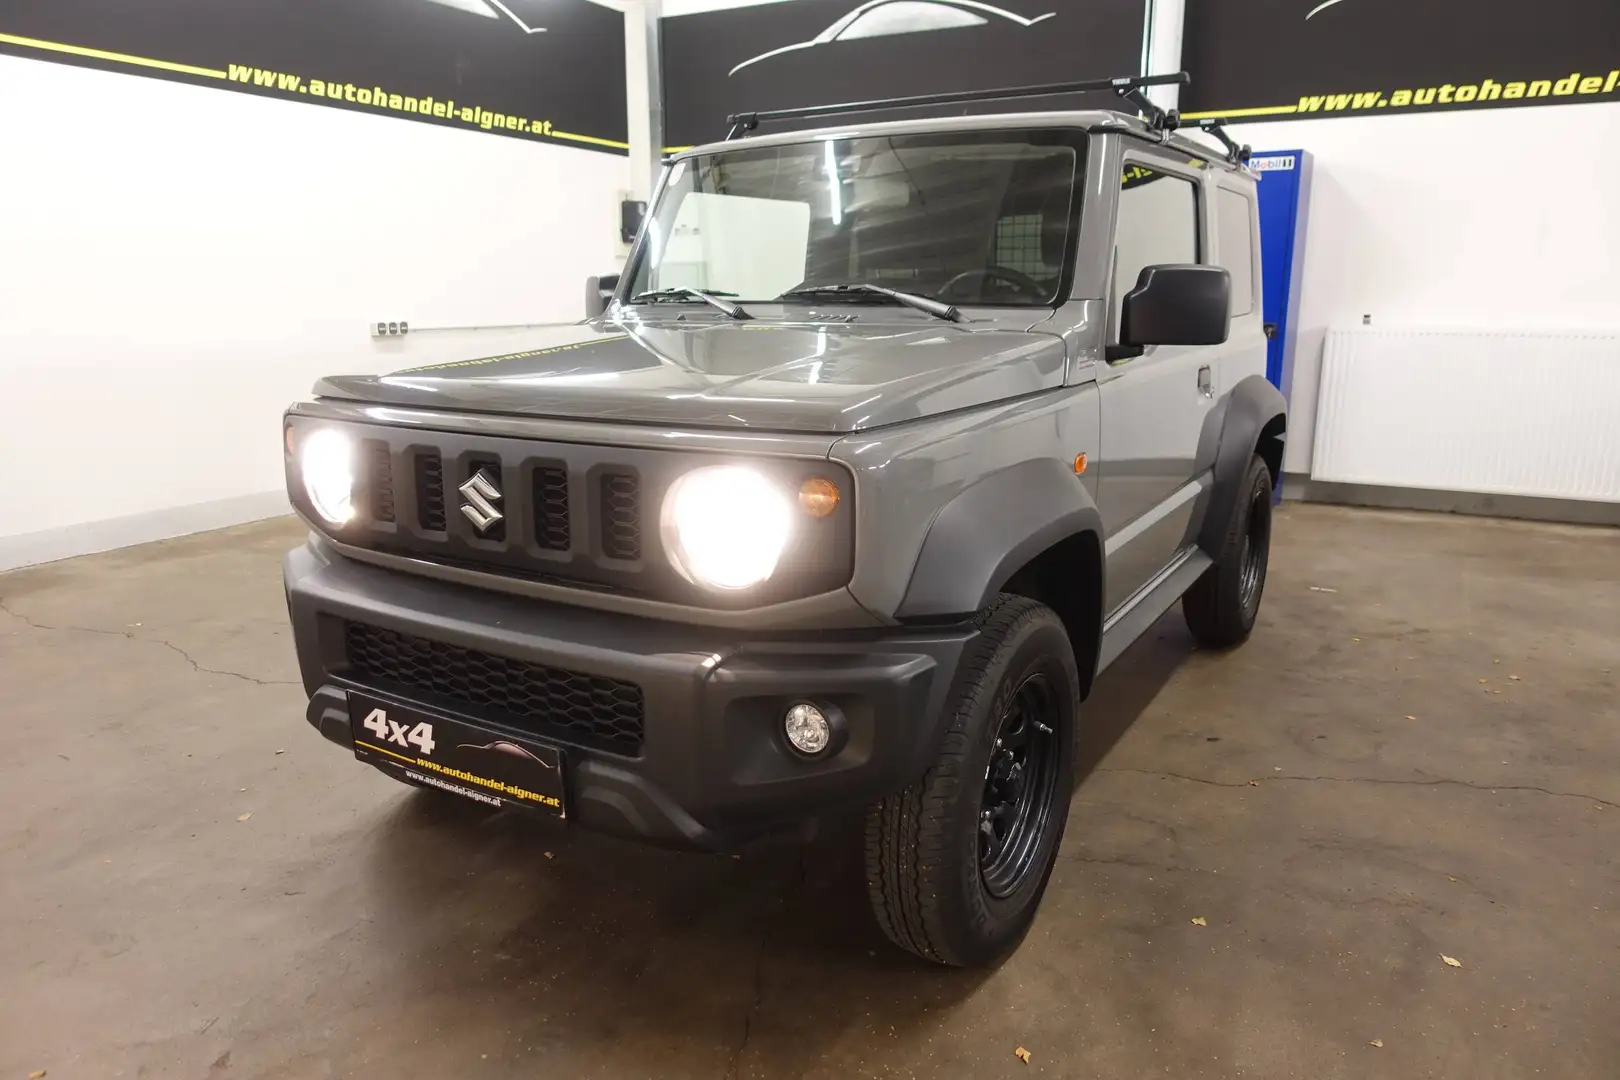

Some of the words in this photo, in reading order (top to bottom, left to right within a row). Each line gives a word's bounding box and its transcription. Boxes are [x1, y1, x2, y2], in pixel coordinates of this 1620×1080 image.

[228, 63, 552, 137] www.autohandel-aigner.at
[1297, 70, 1620, 113] www.autohandel
[364, 708, 435, 755] 4x4
[406, 769, 502, 807] www.autohandel-aigner.at
[416, 757, 560, 807] www.autohandel-aigner.at
